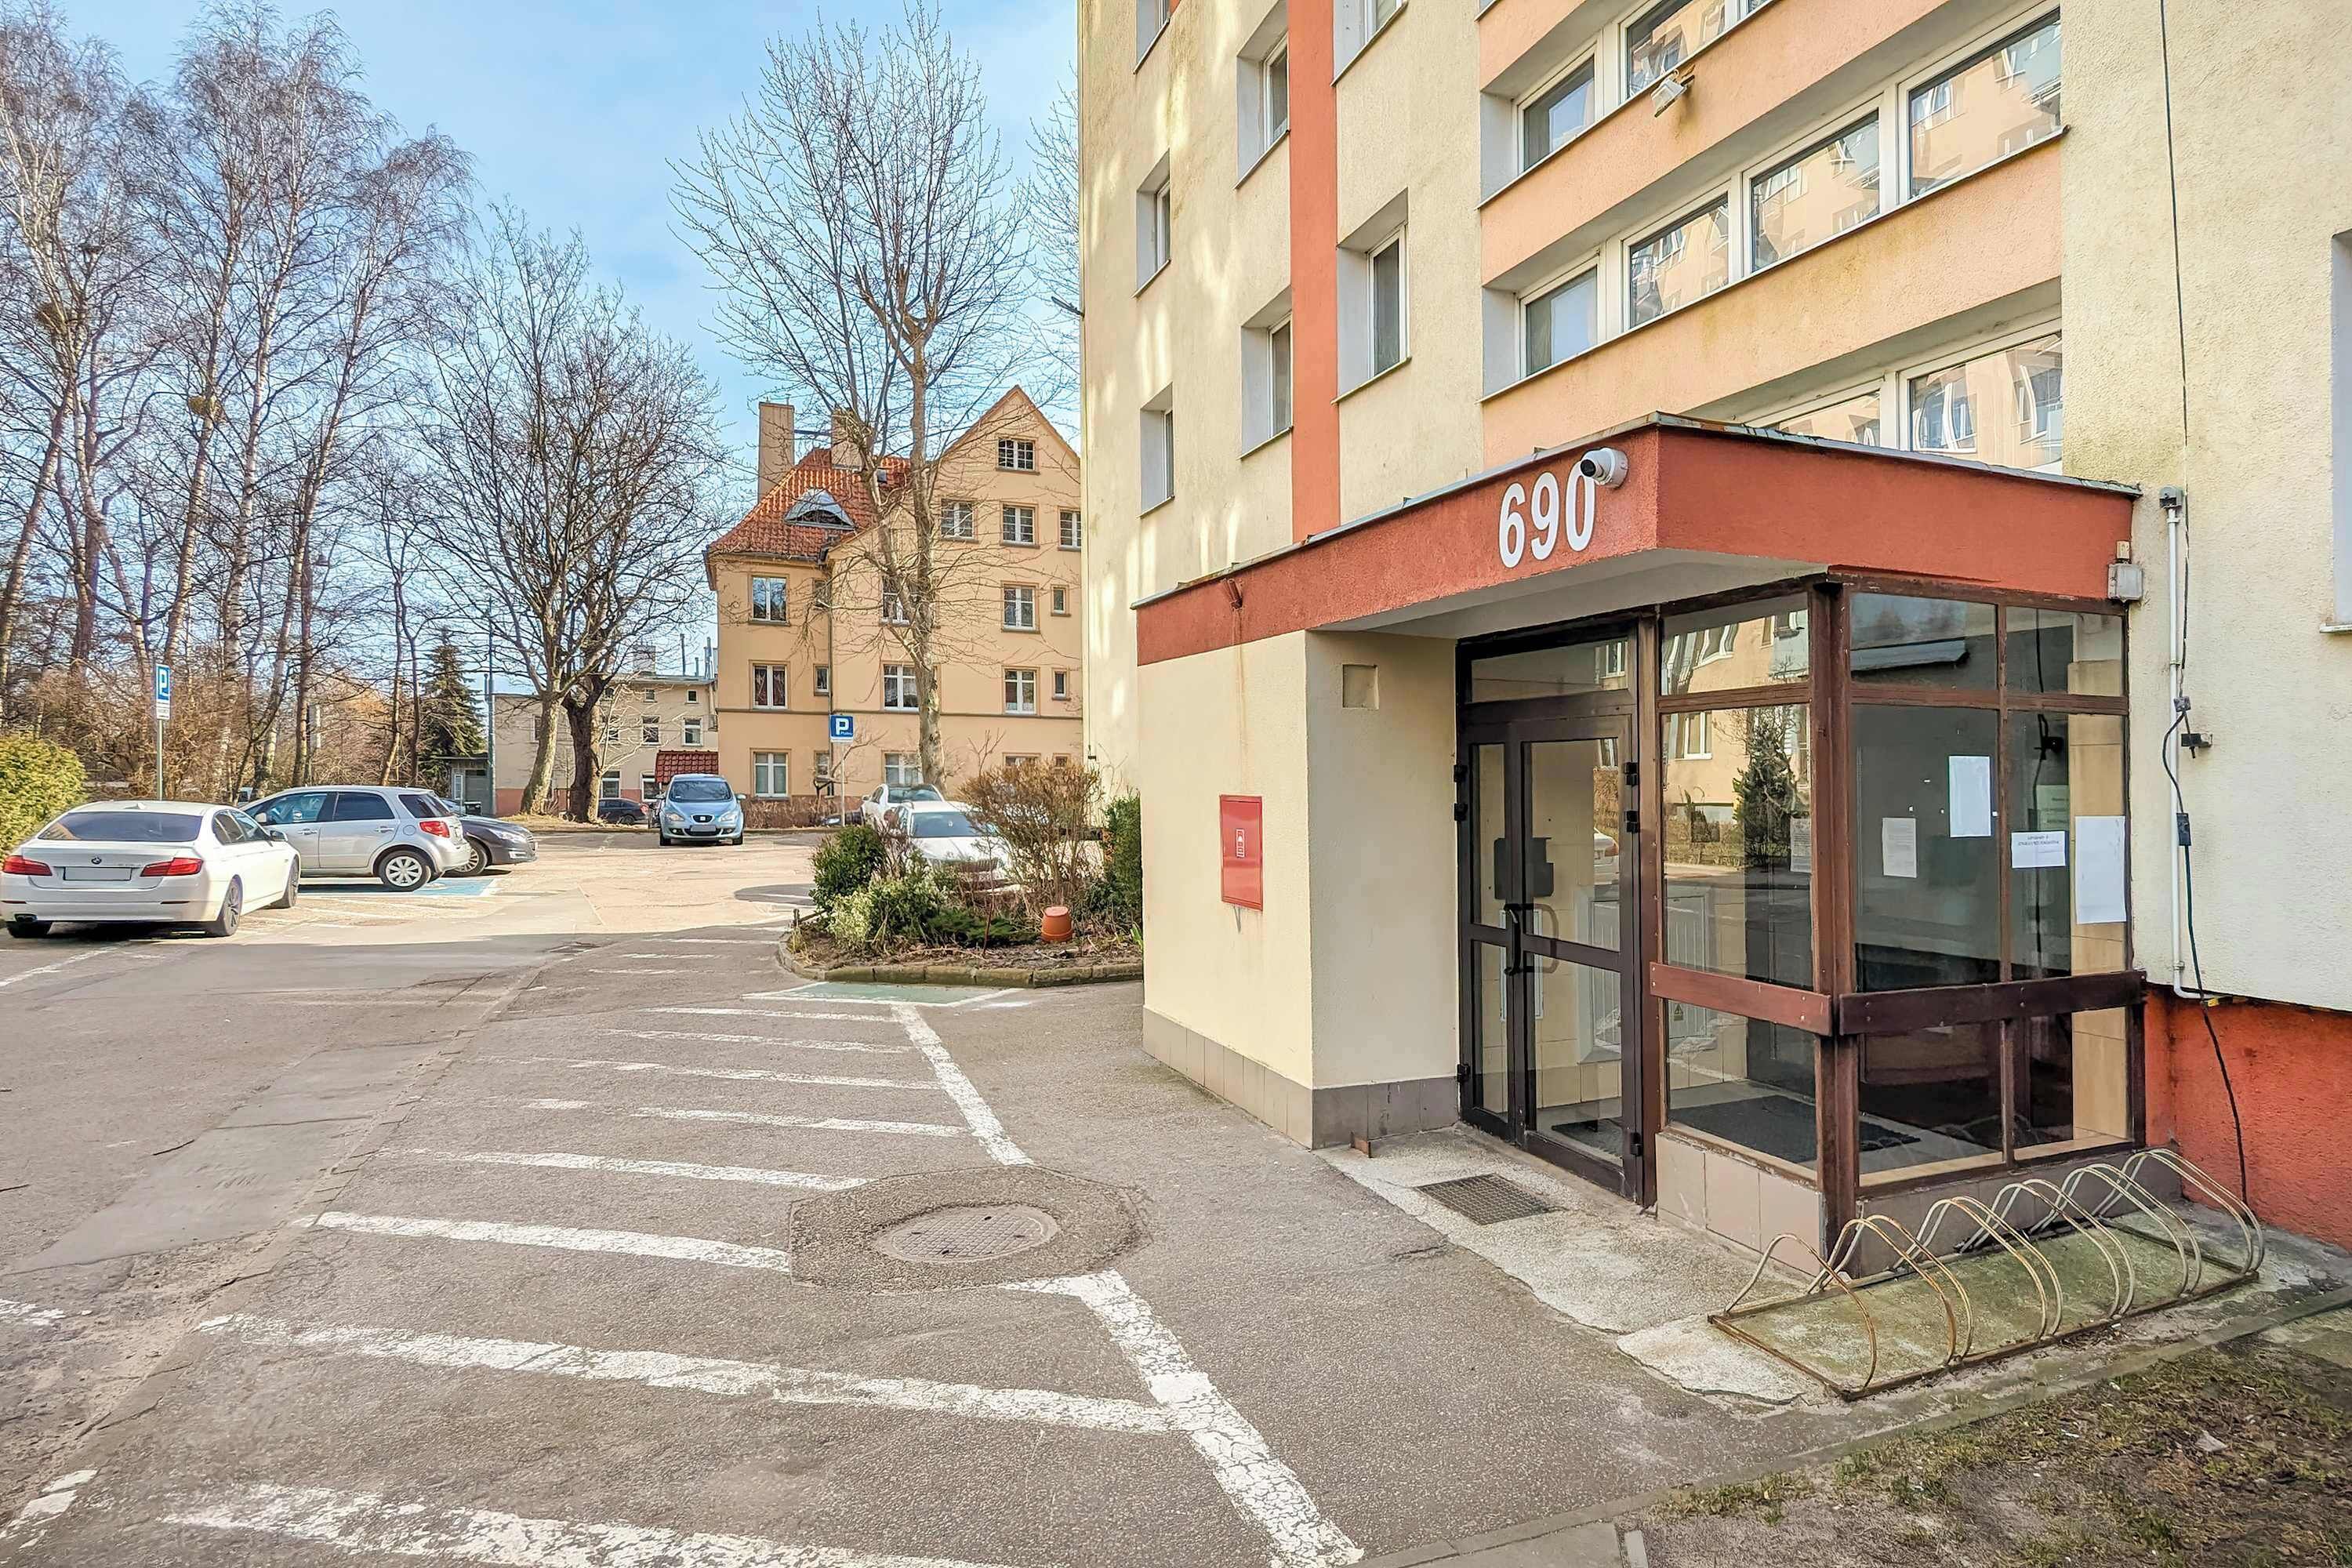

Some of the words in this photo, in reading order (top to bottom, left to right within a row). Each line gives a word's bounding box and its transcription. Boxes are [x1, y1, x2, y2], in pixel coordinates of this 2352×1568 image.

[1498, 460, 1595, 568] 690
[159, 669, 168, 695] P
[836, 717, 849, 735] P
